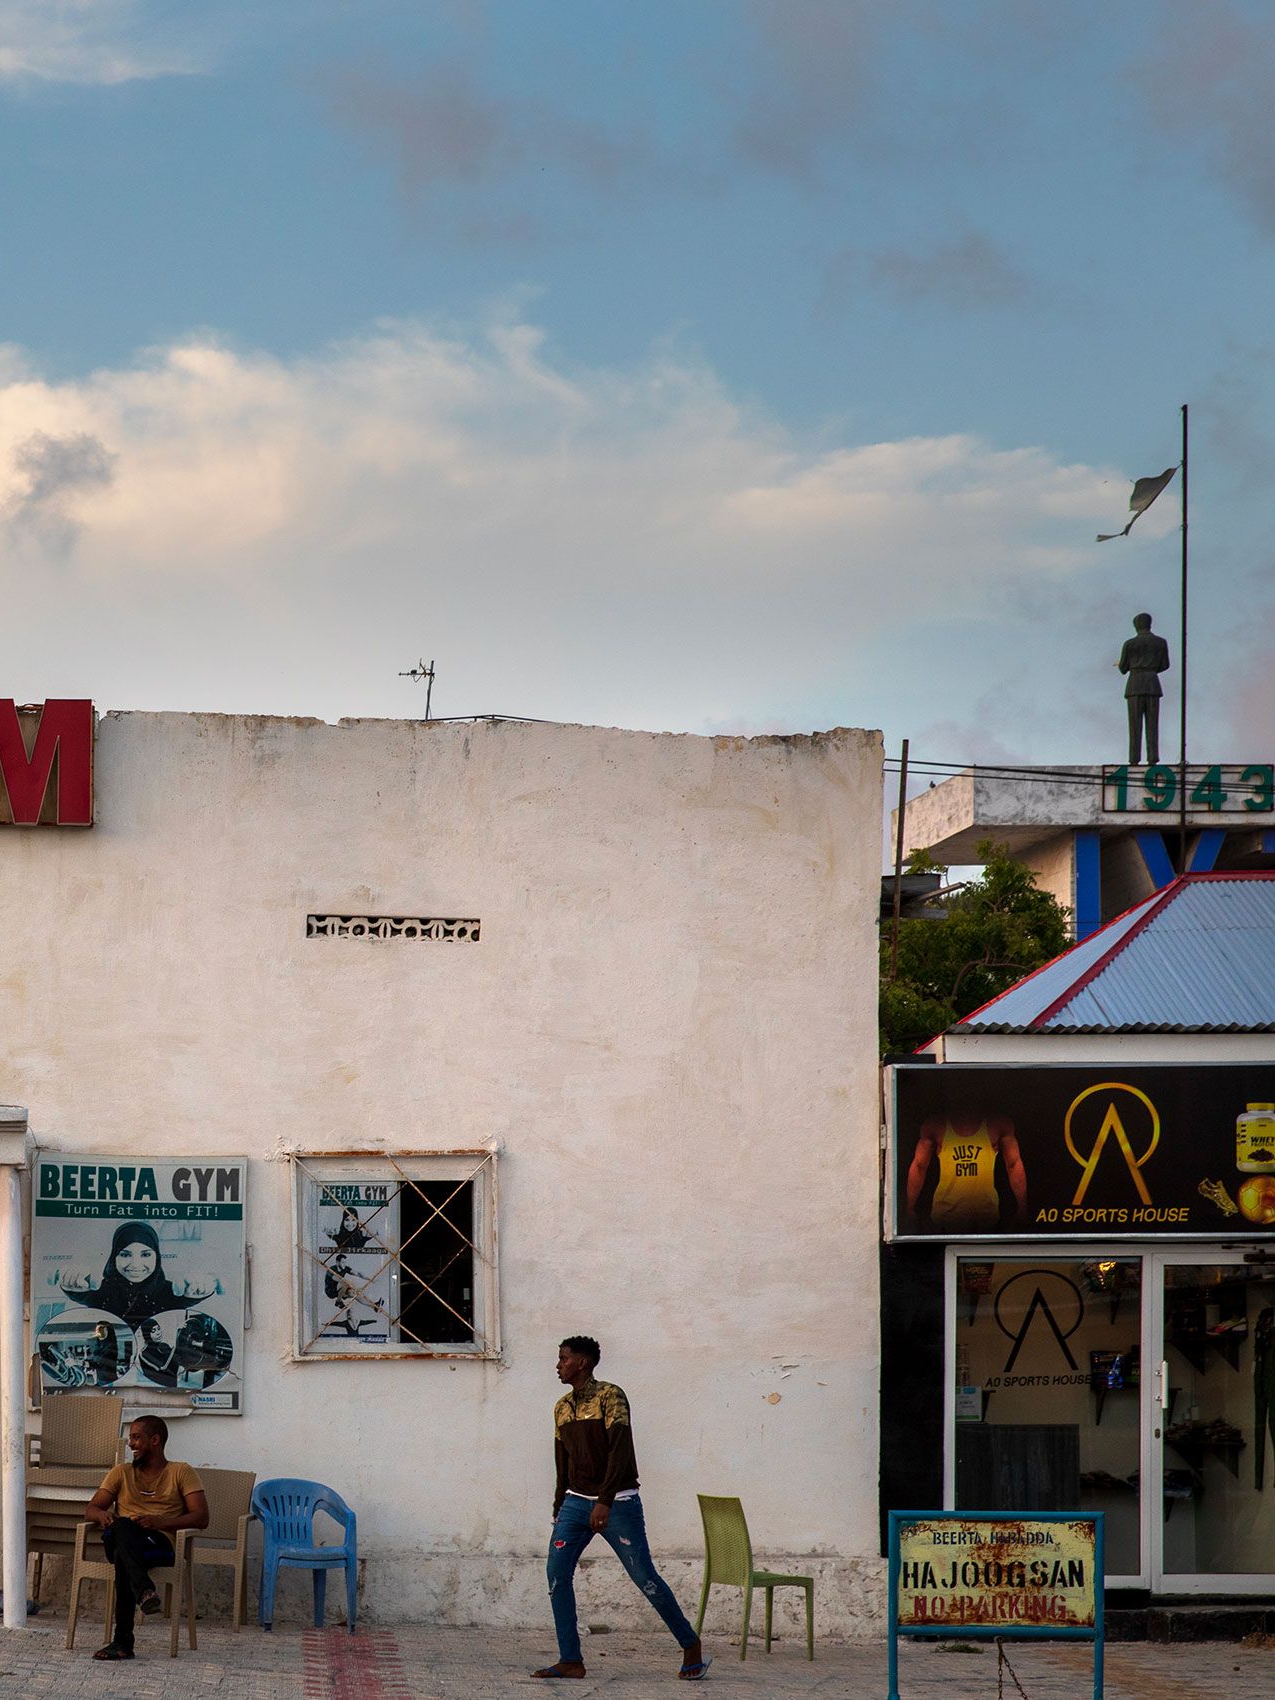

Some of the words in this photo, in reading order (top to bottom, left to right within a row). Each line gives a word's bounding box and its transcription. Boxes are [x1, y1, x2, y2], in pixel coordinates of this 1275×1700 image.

[1106, 765, 1273, 811] 1943
[953, 1145, 982, 1161] JUST
[956, 1163, 977, 1176] GYM
[40, 1164, 159, 1200] BEERTA
[172, 1167, 240, 1202] GYM
[365, 1186, 388, 1200] GYM
[65, 1203, 99, 1215] Turn
[109, 1205, 134, 1216] Fat
[144, 1205, 177, 1217] into
[187, 1206, 219, 1217] FIT!
[1062, 1208, 1127, 1222] SPORTS
[1132, 1208, 1190, 1222] HOUSE
[1004, 1376, 1049, 1387] SPORTS
[1053, 1374, 1092, 1385] HOUSE
[933, 1532, 982, 1544] BEERTA
[914, 1596, 945, 1619] NO
[959, 1595, 1066, 1620] PARKING
